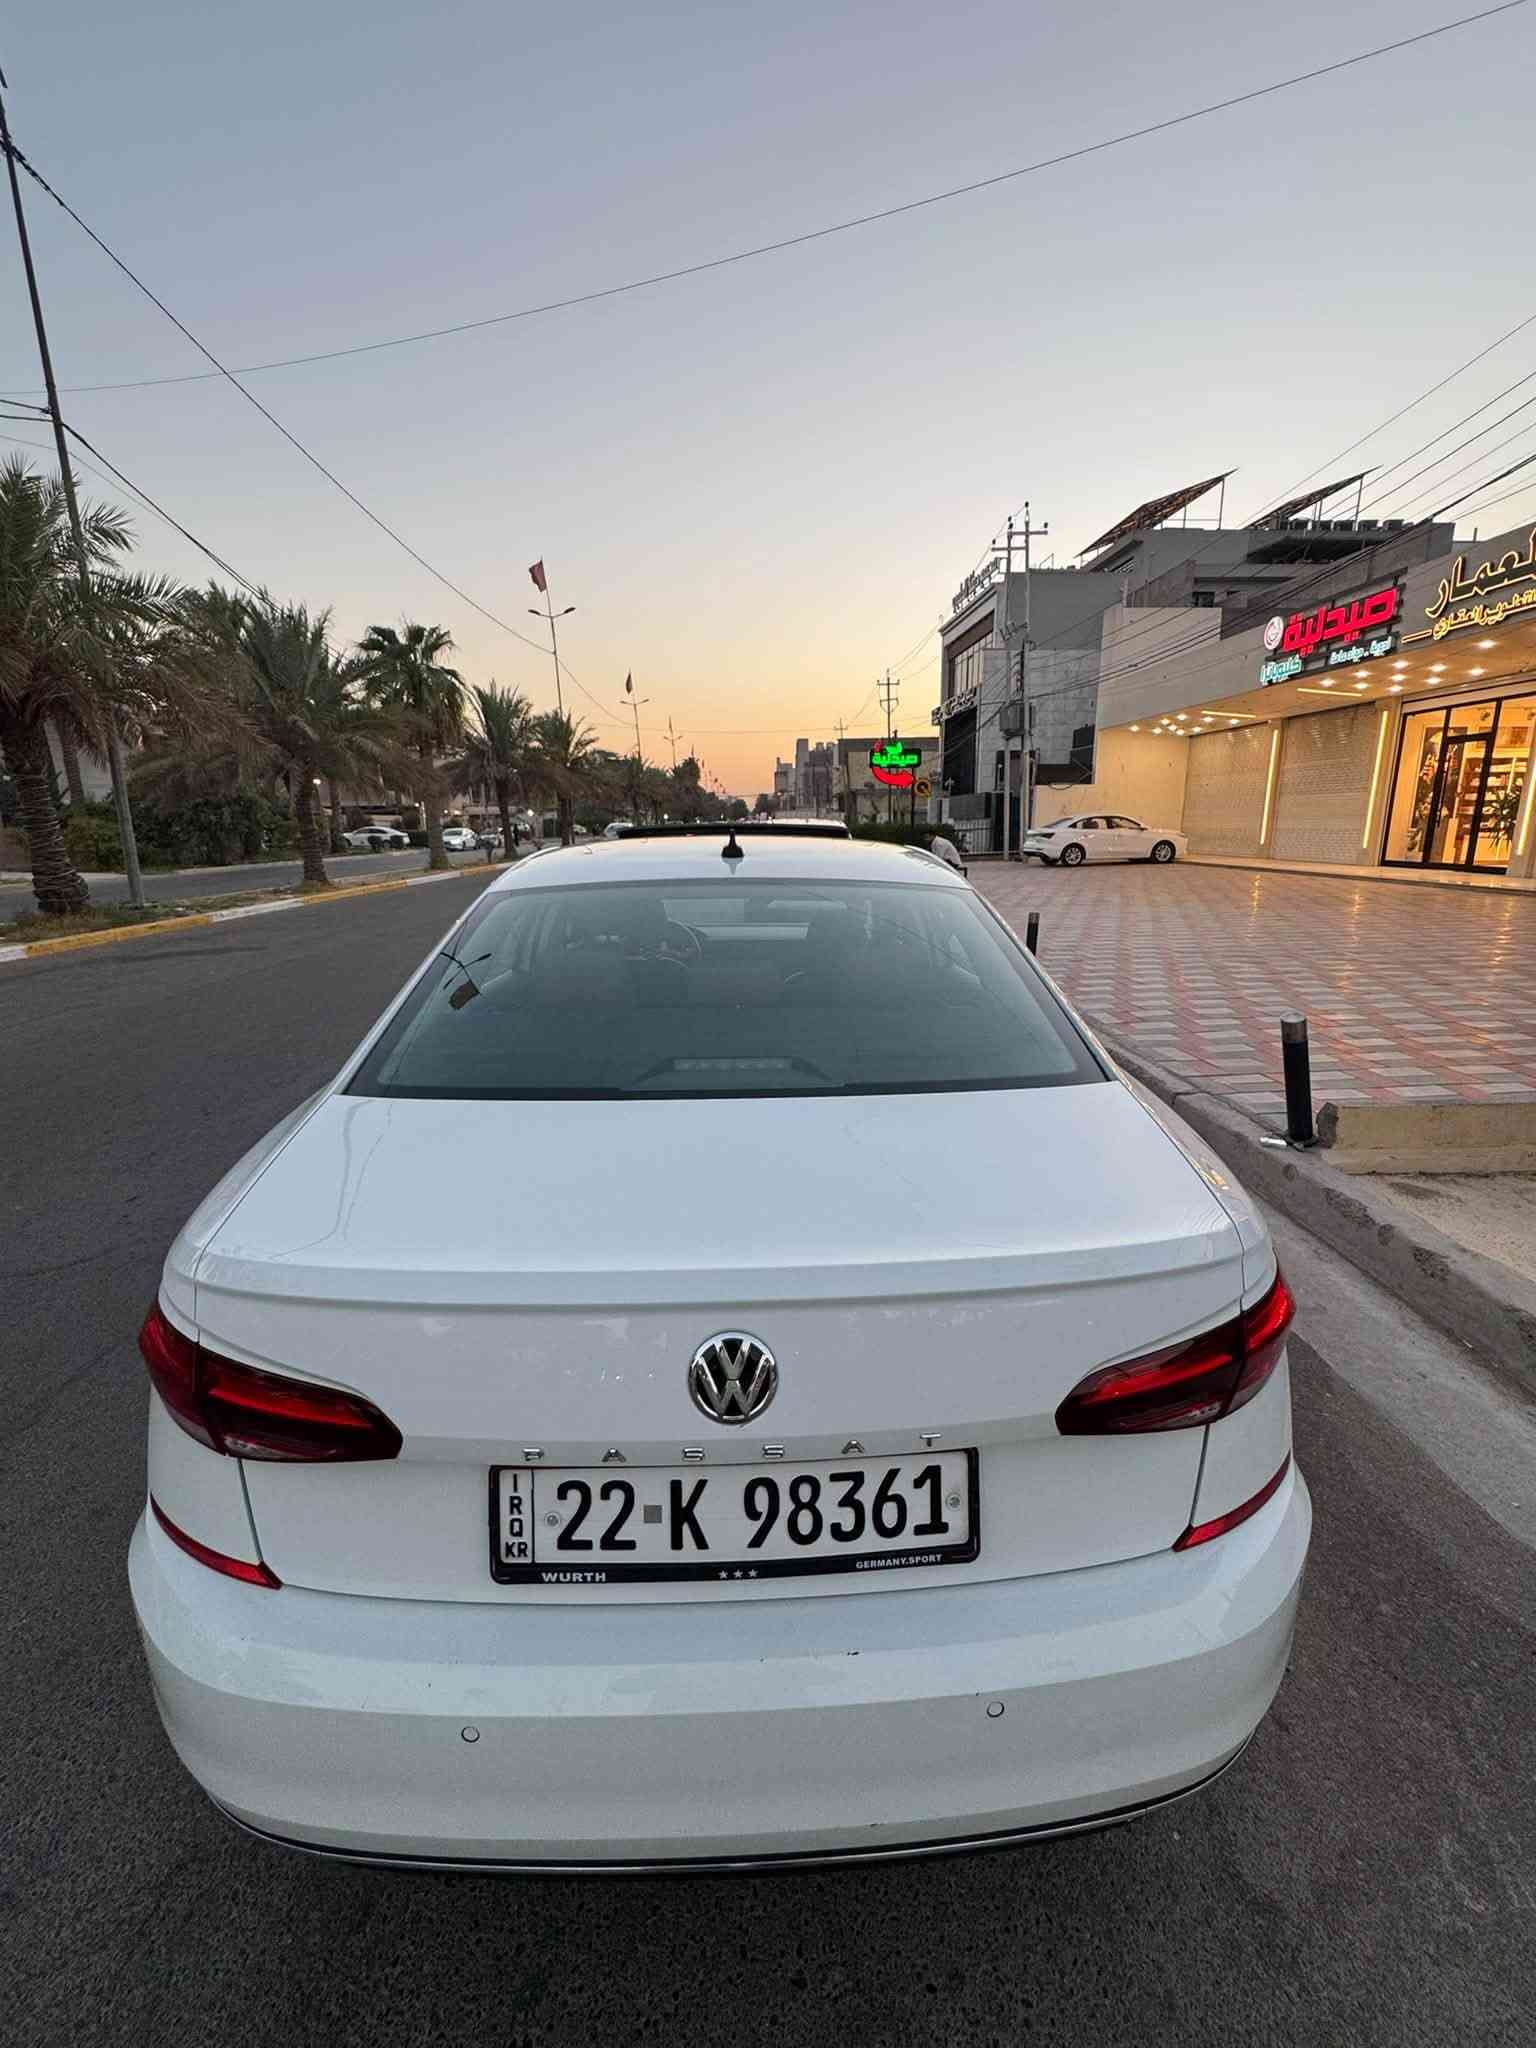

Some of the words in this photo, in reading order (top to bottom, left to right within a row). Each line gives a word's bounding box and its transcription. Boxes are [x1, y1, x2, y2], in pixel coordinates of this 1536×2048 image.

[1282, 586, 1398, 656] صيدلية
[872, 752, 918, 768] صيدلية
[691, 1334, 776, 1421] VW
[522, 1432, 942, 1463] PASSAT
[509, 1474, 523, 1537] IRQ
[556, 1479, 637, 1551] 22
[669, 1479, 709, 1551] K
[743, 1464, 949, 1549] 98361
[505, 1541, 528, 1558] KR
[542, 1571, 607, 1583] WURTH
